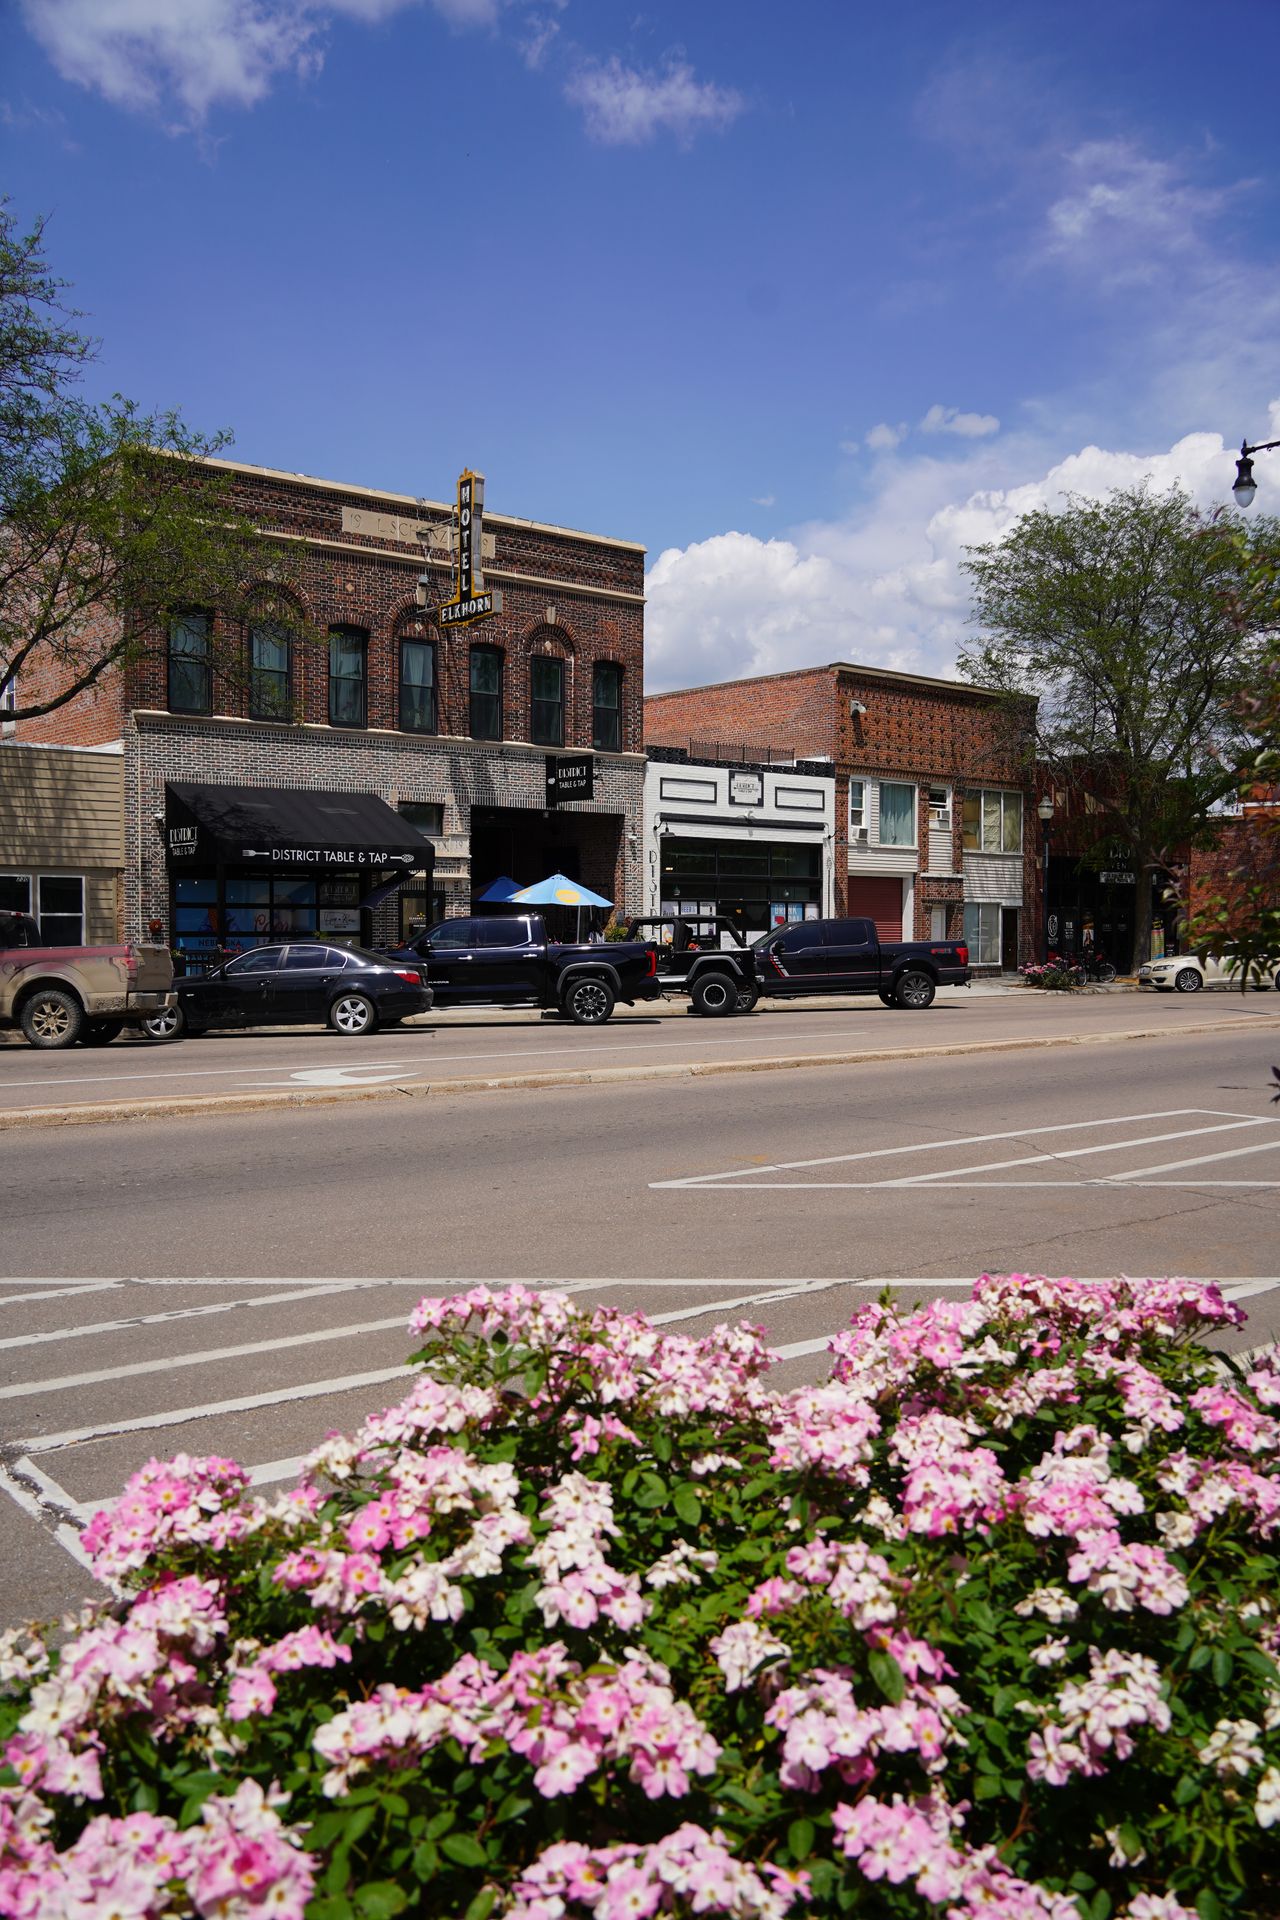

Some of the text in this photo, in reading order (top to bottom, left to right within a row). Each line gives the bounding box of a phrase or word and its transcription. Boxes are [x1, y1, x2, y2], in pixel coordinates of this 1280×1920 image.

[461, 485, 471, 592] HOTEL
[441, 596, 491, 622] ELKHORN
[558, 766, 587, 779] DISTRICT
[559, 780, 572, 789] TABLE
[577, 779, 587, 787] TAP
[169, 826, 198, 842] DISTRICT
[171, 847, 184, 856] TABLE
[188, 846, 196, 855] TAP
[272, 849, 388, 864] DISTRICT TABLE & TAP
